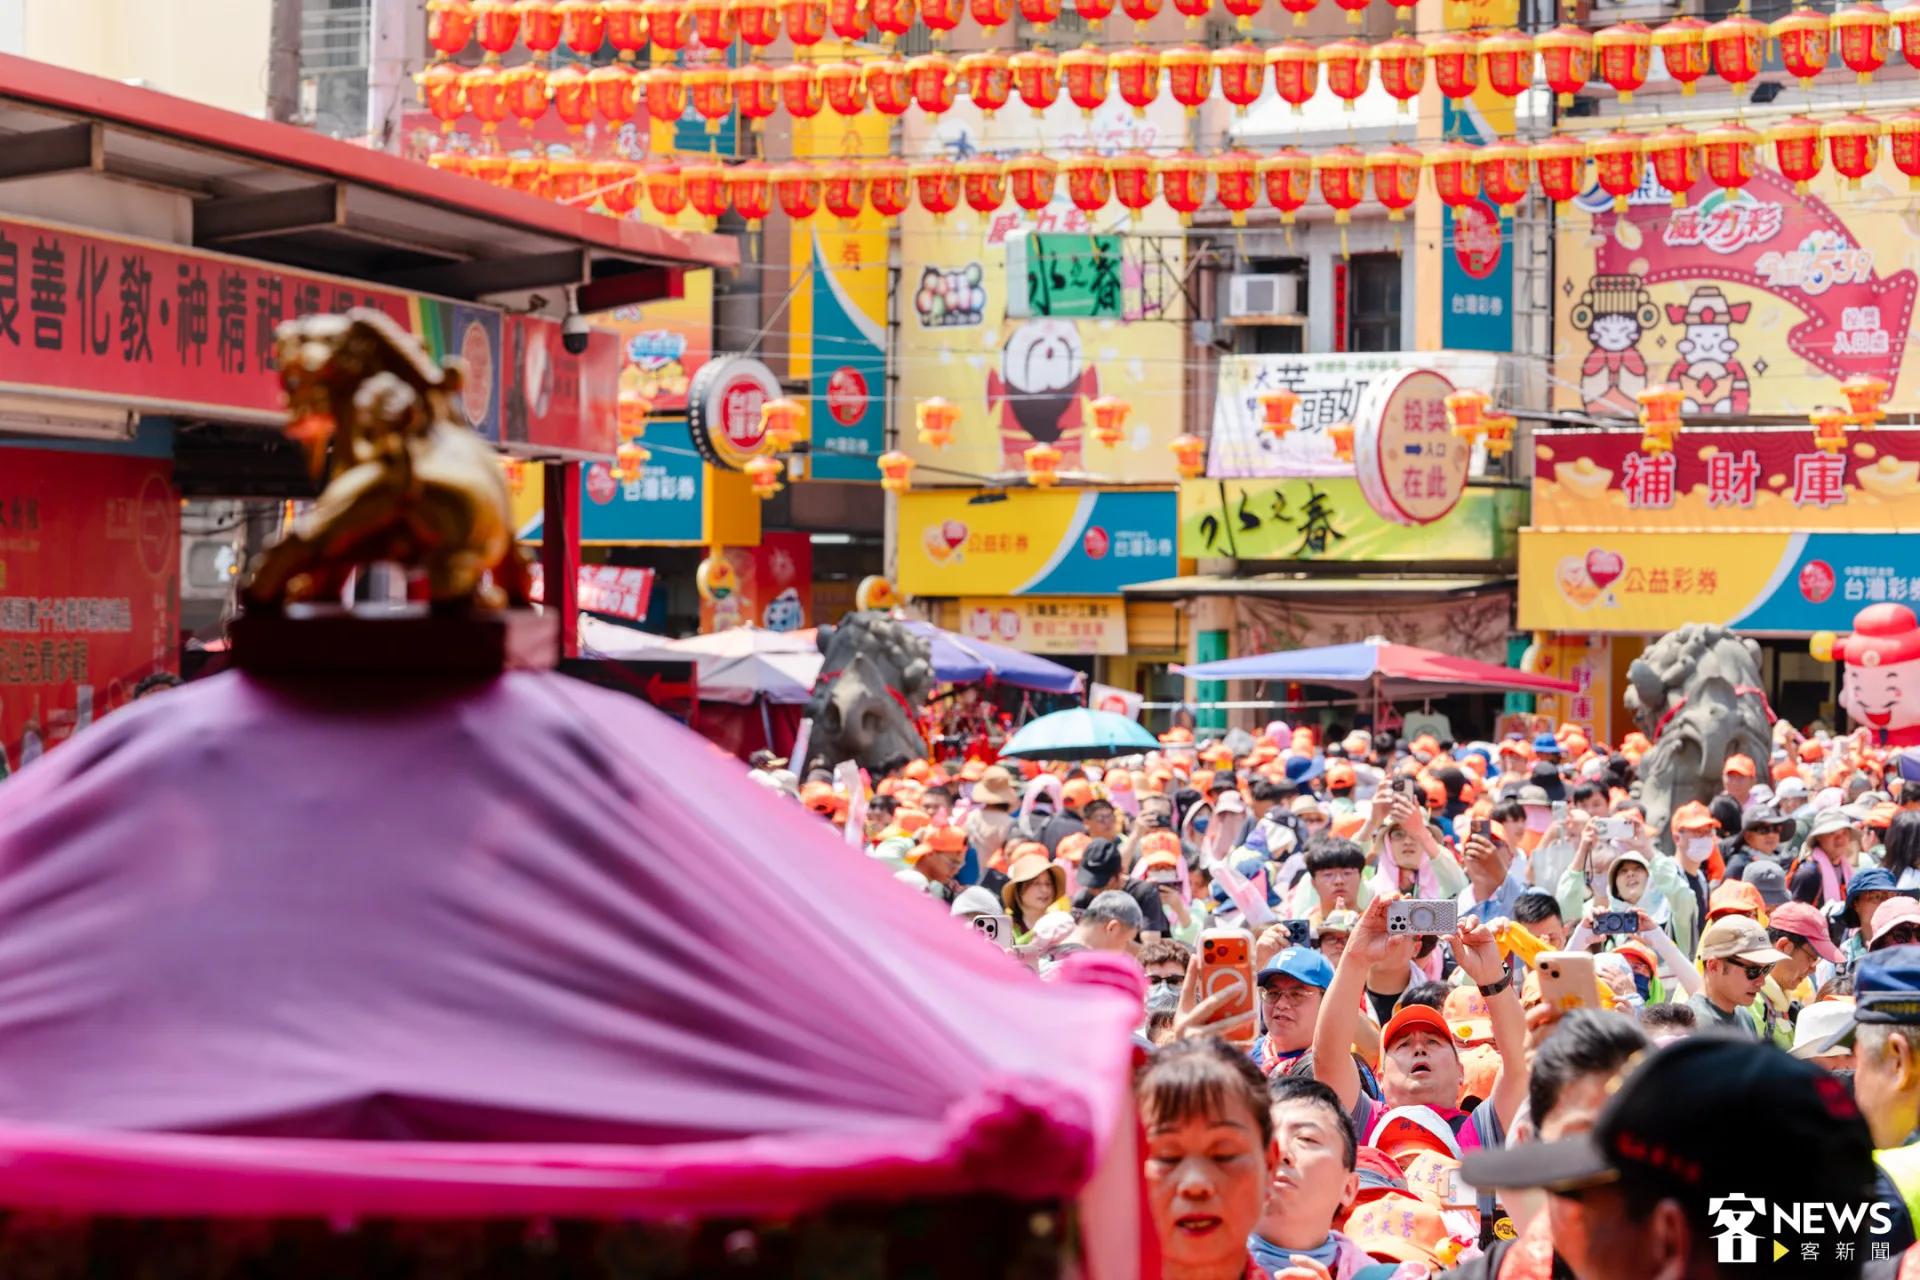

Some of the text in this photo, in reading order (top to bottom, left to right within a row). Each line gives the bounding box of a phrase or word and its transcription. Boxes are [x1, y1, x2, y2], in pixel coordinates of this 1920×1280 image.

[1664, 202, 1783, 254] 威力彩
[1403, 467, 1447, 500] 在此
[1622, 450, 1848, 508] 補財庫
[1623, 565, 1719, 596] 公益彩券
